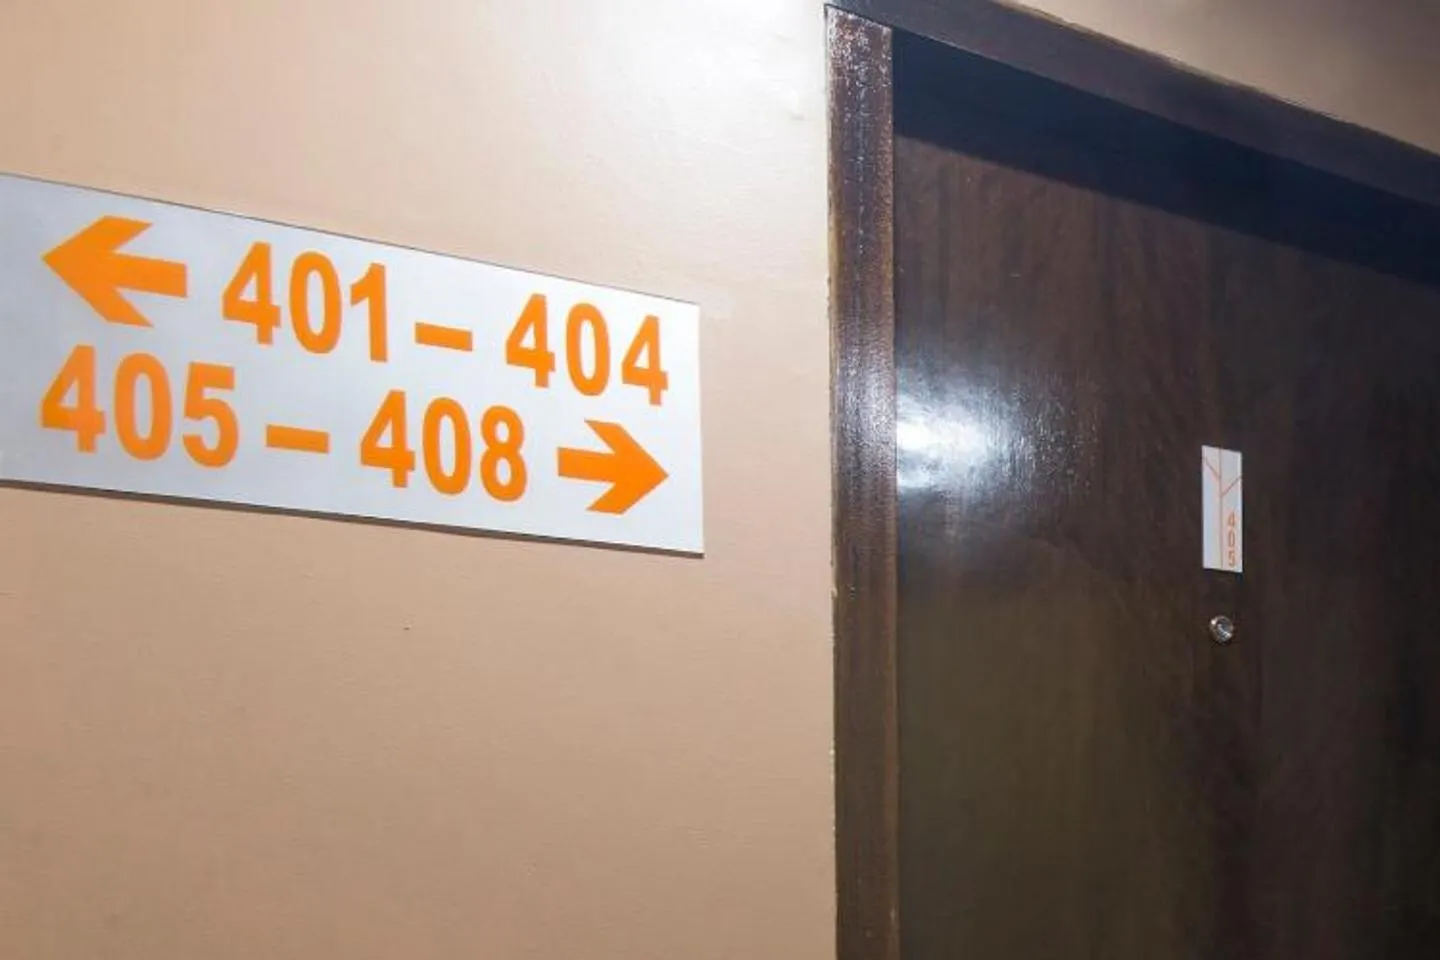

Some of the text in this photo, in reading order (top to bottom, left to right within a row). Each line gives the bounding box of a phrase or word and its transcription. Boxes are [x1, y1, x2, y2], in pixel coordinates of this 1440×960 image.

[222, 242, 388, 361] 401
[506, 293, 668, 406] 404
[40, 344, 239, 468] 405
[360, 390, 527, 502] 408
[1227, 511, 1236, 568] 405
